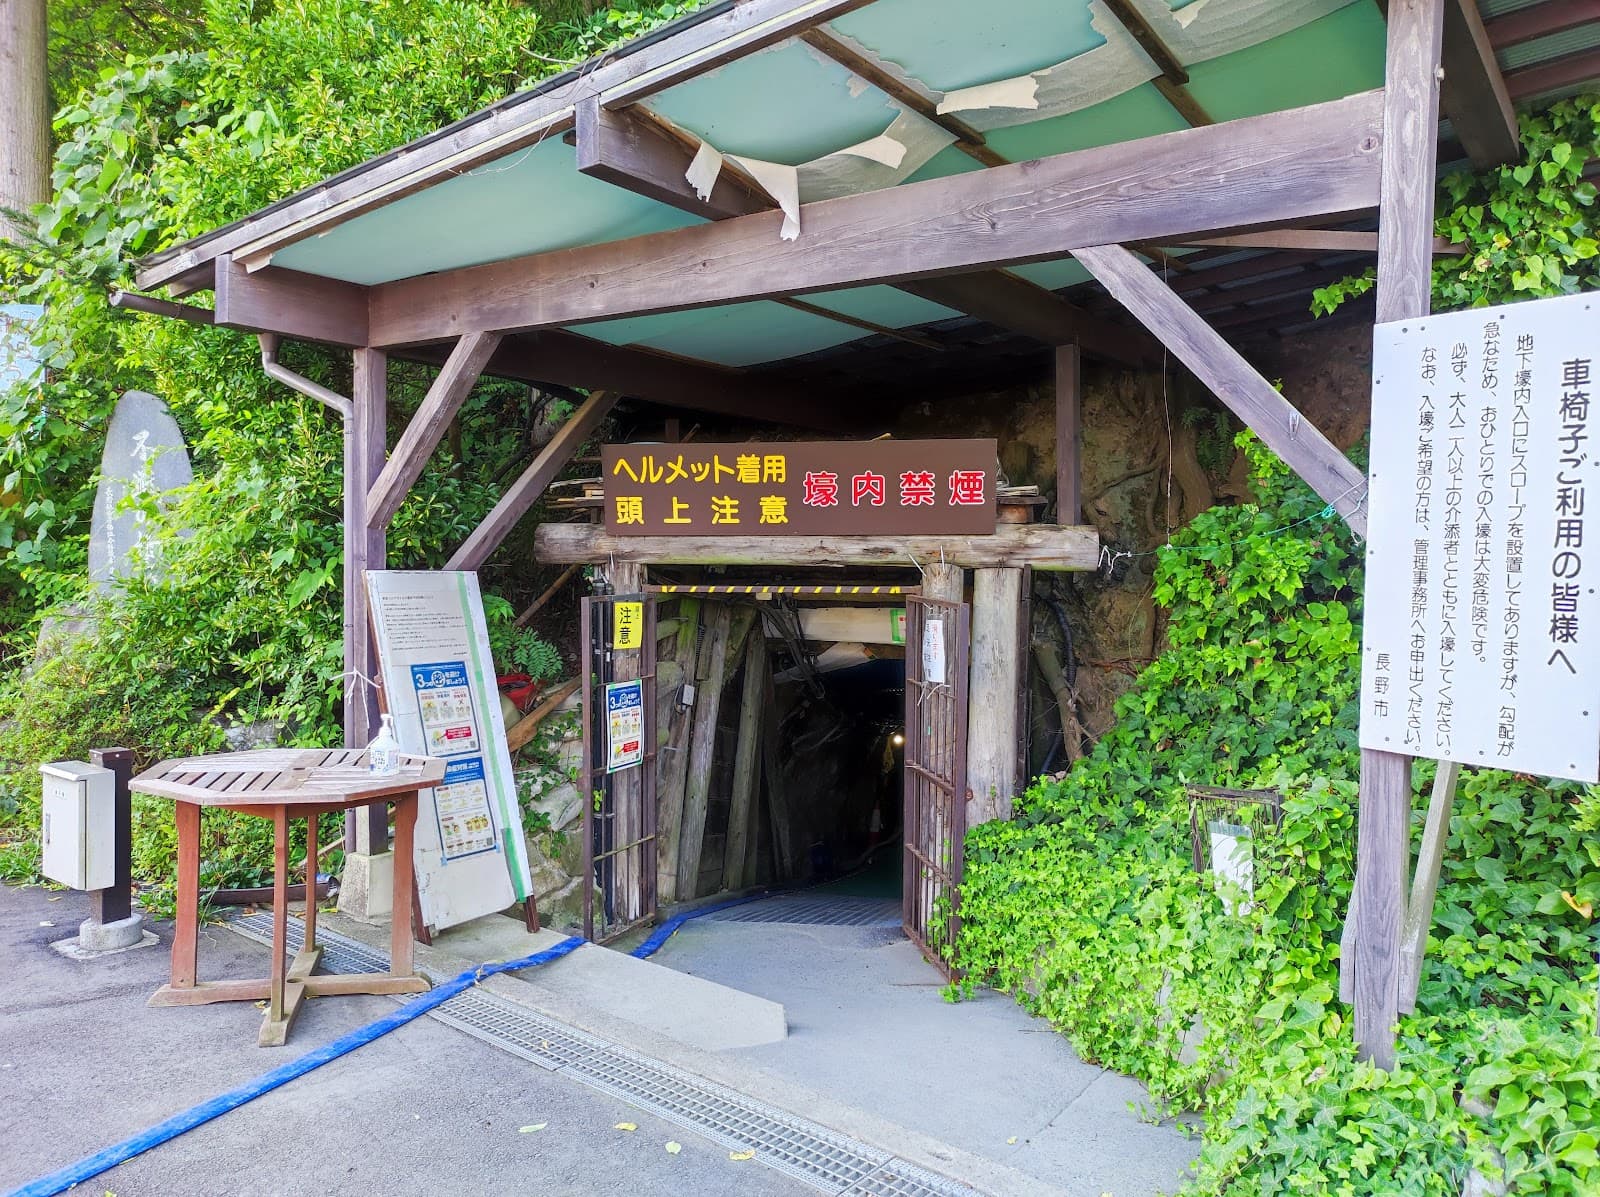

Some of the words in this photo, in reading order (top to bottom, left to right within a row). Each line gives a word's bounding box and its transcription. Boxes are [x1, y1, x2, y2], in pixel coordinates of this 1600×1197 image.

[613, 454, 787, 485] ヘルメット着用
[803, 469, 985, 507] 壕内禁煙
[615, 495, 789, 526] 頭上注意
[1547, 357, 1592, 675] 車椅子ご利用の皆様へ
[619, 606, 632, 645] 注意
[1373, 653, 1391, 718] 長野市
